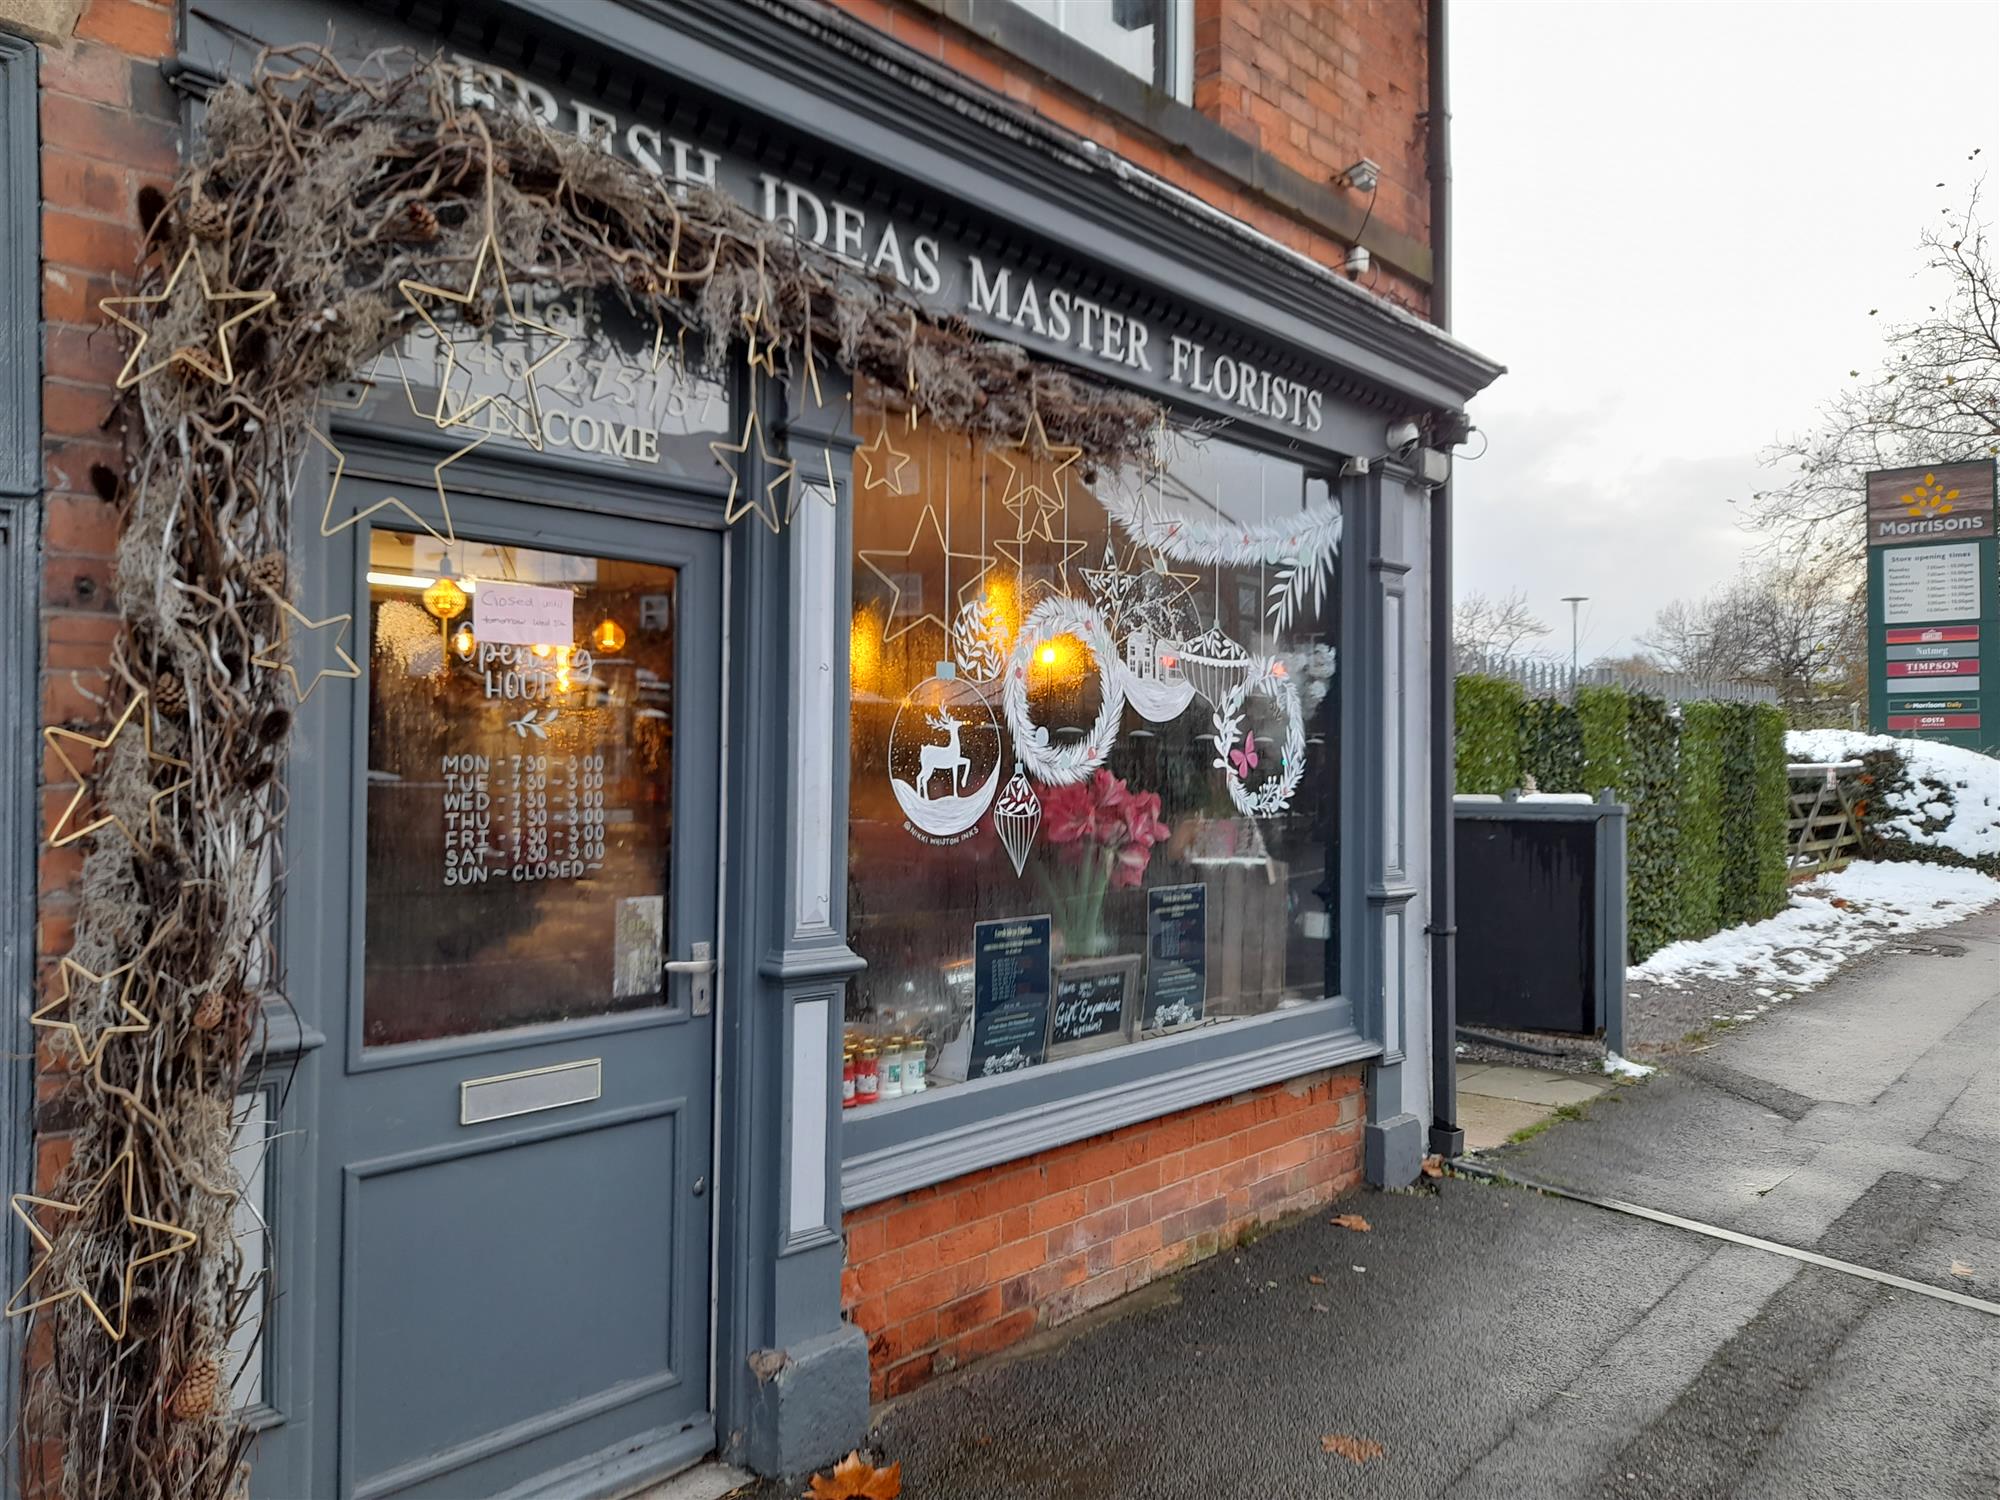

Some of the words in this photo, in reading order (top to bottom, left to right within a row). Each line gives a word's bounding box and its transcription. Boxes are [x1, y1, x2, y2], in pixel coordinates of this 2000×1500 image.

[760, 172, 941, 294] IDEAS
[968, 255, 1152, 372] MASTER
[1170, 334, 1323, 432] FLORISTS
[444, 388, 660, 464] WELCOME
[1880, 516, 1984, 536] Morrisons
[481, 590, 534, 607] Closed
[1906, 661, 1959, 671] TIMPSON
[442, 755, 490, 773] MON
[444, 774, 489, 792] TUE
[443, 792, 490, 811] WED
[444, 811, 490, 829] THU
[445, 829, 490, 849] FRI
[961, 826, 979, 841] INKS
[444, 848, 489, 867] SAT
[444, 866, 488, 886] SUN
[511, 860, 584, 882] CLOSED
[1055, 1000, 1082, 1033] Gift
